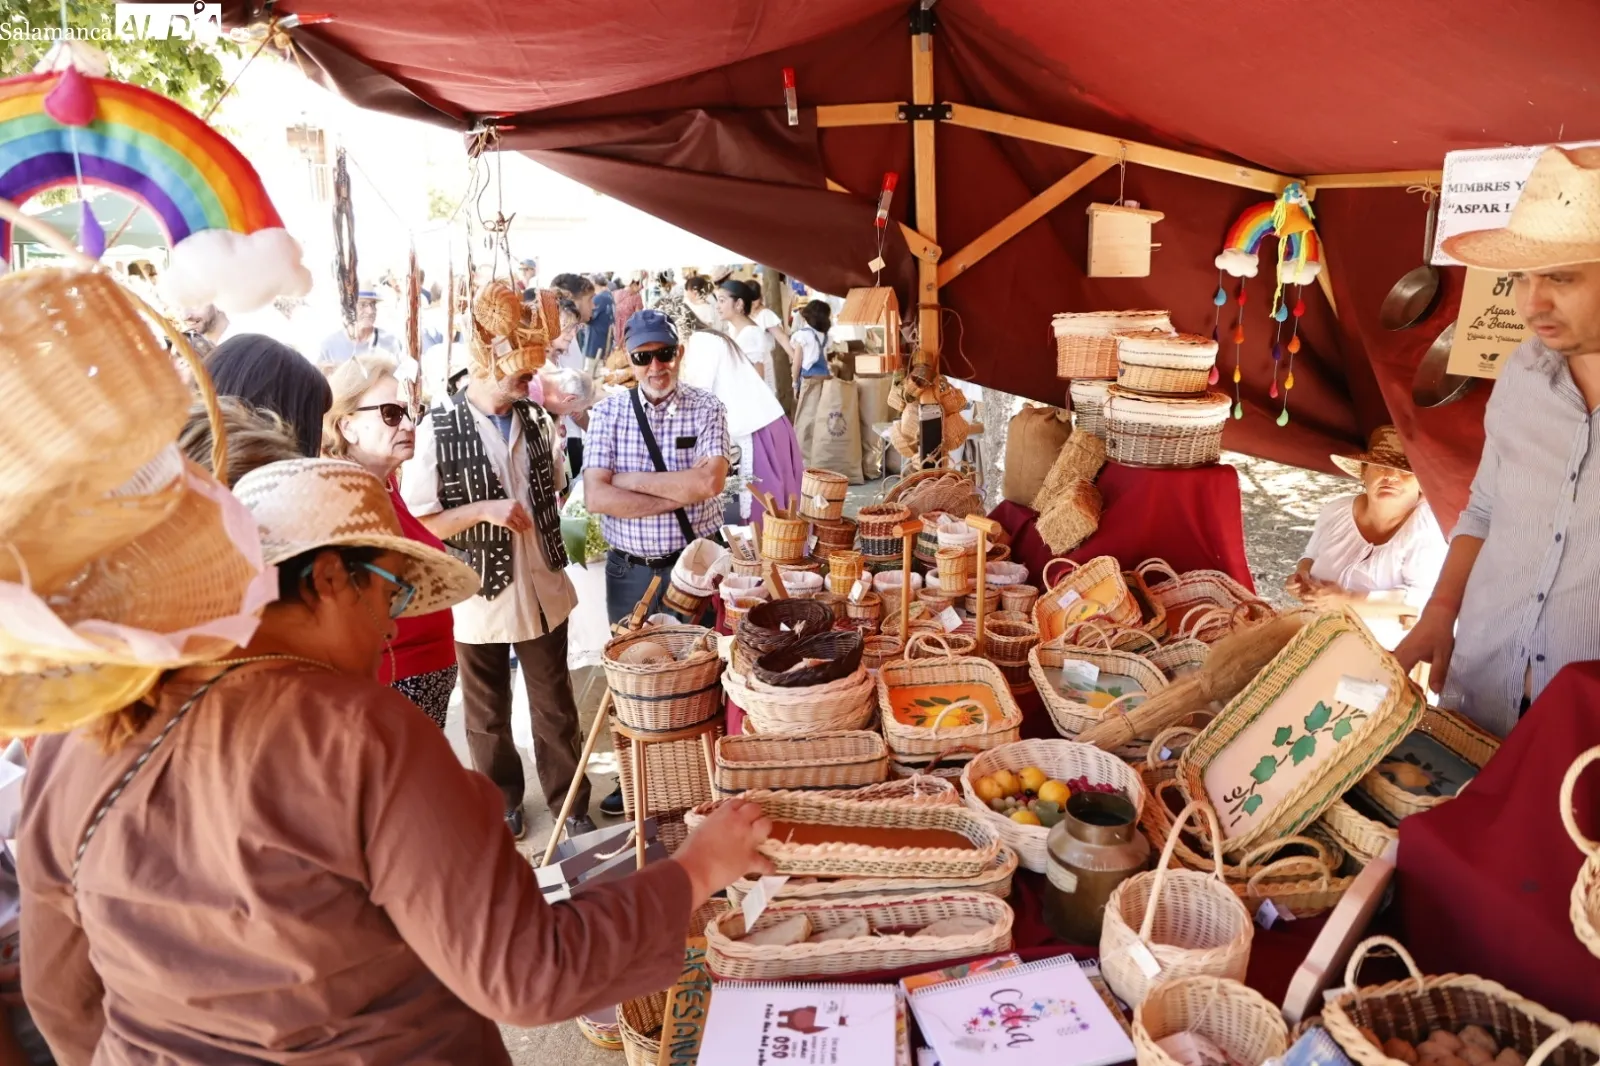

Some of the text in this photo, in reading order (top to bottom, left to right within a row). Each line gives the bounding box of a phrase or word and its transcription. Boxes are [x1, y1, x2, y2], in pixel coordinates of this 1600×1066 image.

[1447, 181, 1511, 193] MIMBRES
[1504, 203, 1514, 213] L
[1483, 304, 1517, 317] Aspar
[1469, 316, 1525, 331] La Besana
[990, 988, 1040, 1048] Celia
[771, 1036, 791, 1059] OSO
